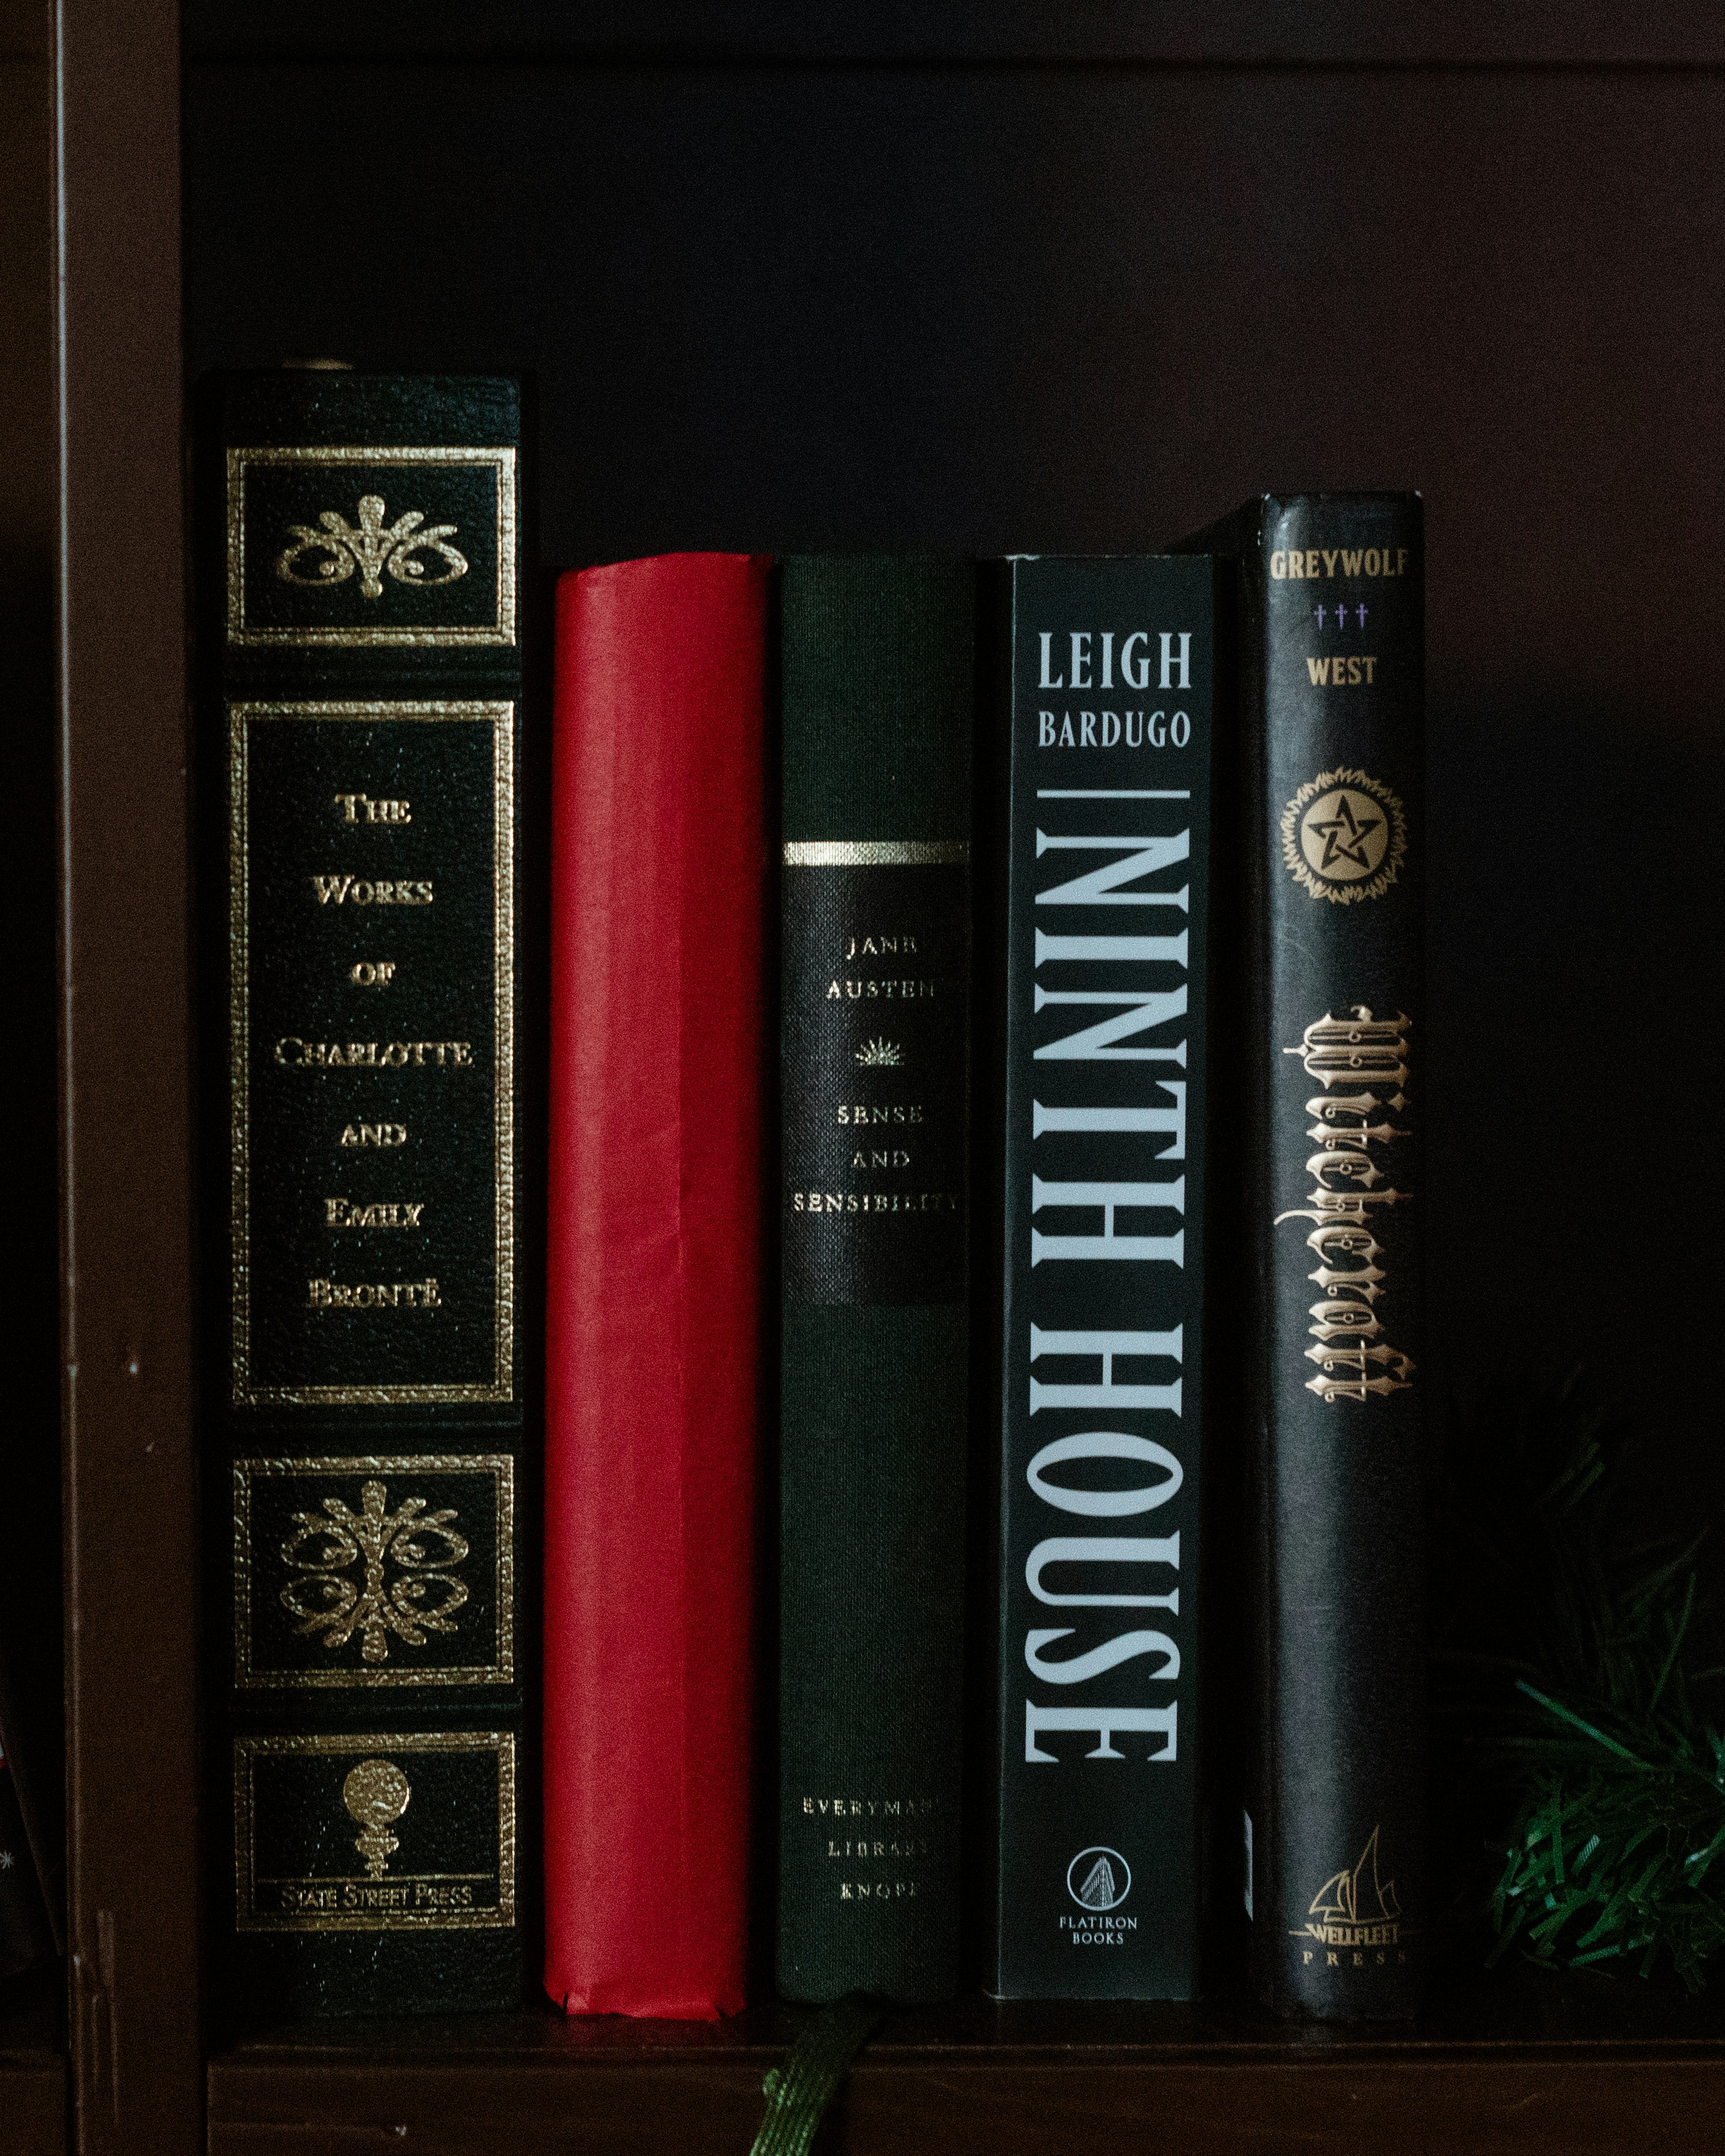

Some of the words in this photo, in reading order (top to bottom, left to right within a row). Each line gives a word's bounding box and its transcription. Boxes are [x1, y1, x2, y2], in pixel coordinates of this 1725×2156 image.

[1270, 548, 1410, 580] GREYWOLF
[1038, 632, 1192, 689] LEIGH
[1306, 655, 1378, 686] WEST
[1038, 710, 1191, 748] BARDUGO
[334, 793, 412, 824] THE
[312, 875, 434, 906] WORKS
[826, 979, 934, 999] AUSTEN
[274, 1036, 473, 1068] CHARLOTTE
[1031, 827, 1191, 1269] NINTH
[837, 1105, 922, 1125] SENSE
[340, 1122, 408, 1147] AND
[852, 1150, 910, 1169] AND
[324, 1197, 424, 1227] EMILY
[792, 1192, 961, 1212] SENSIBILITY
[1274, 1004, 1417, 1403] Witchcraft
[1025, 1321, 1184, 1764] HOUSE
[281, 1884, 337, 1908] STATE
[344, 1882, 409, 1908] STREET
[415, 1881, 473, 1906] PRESS
[1059, 1916, 1138, 1930] FLATIRON
[1304, 1922, 1400, 1947] WELLFLEET
[1072, 1932, 1124, 1945] BOOKS
[1302, 1950, 1408, 1967] PRESS
